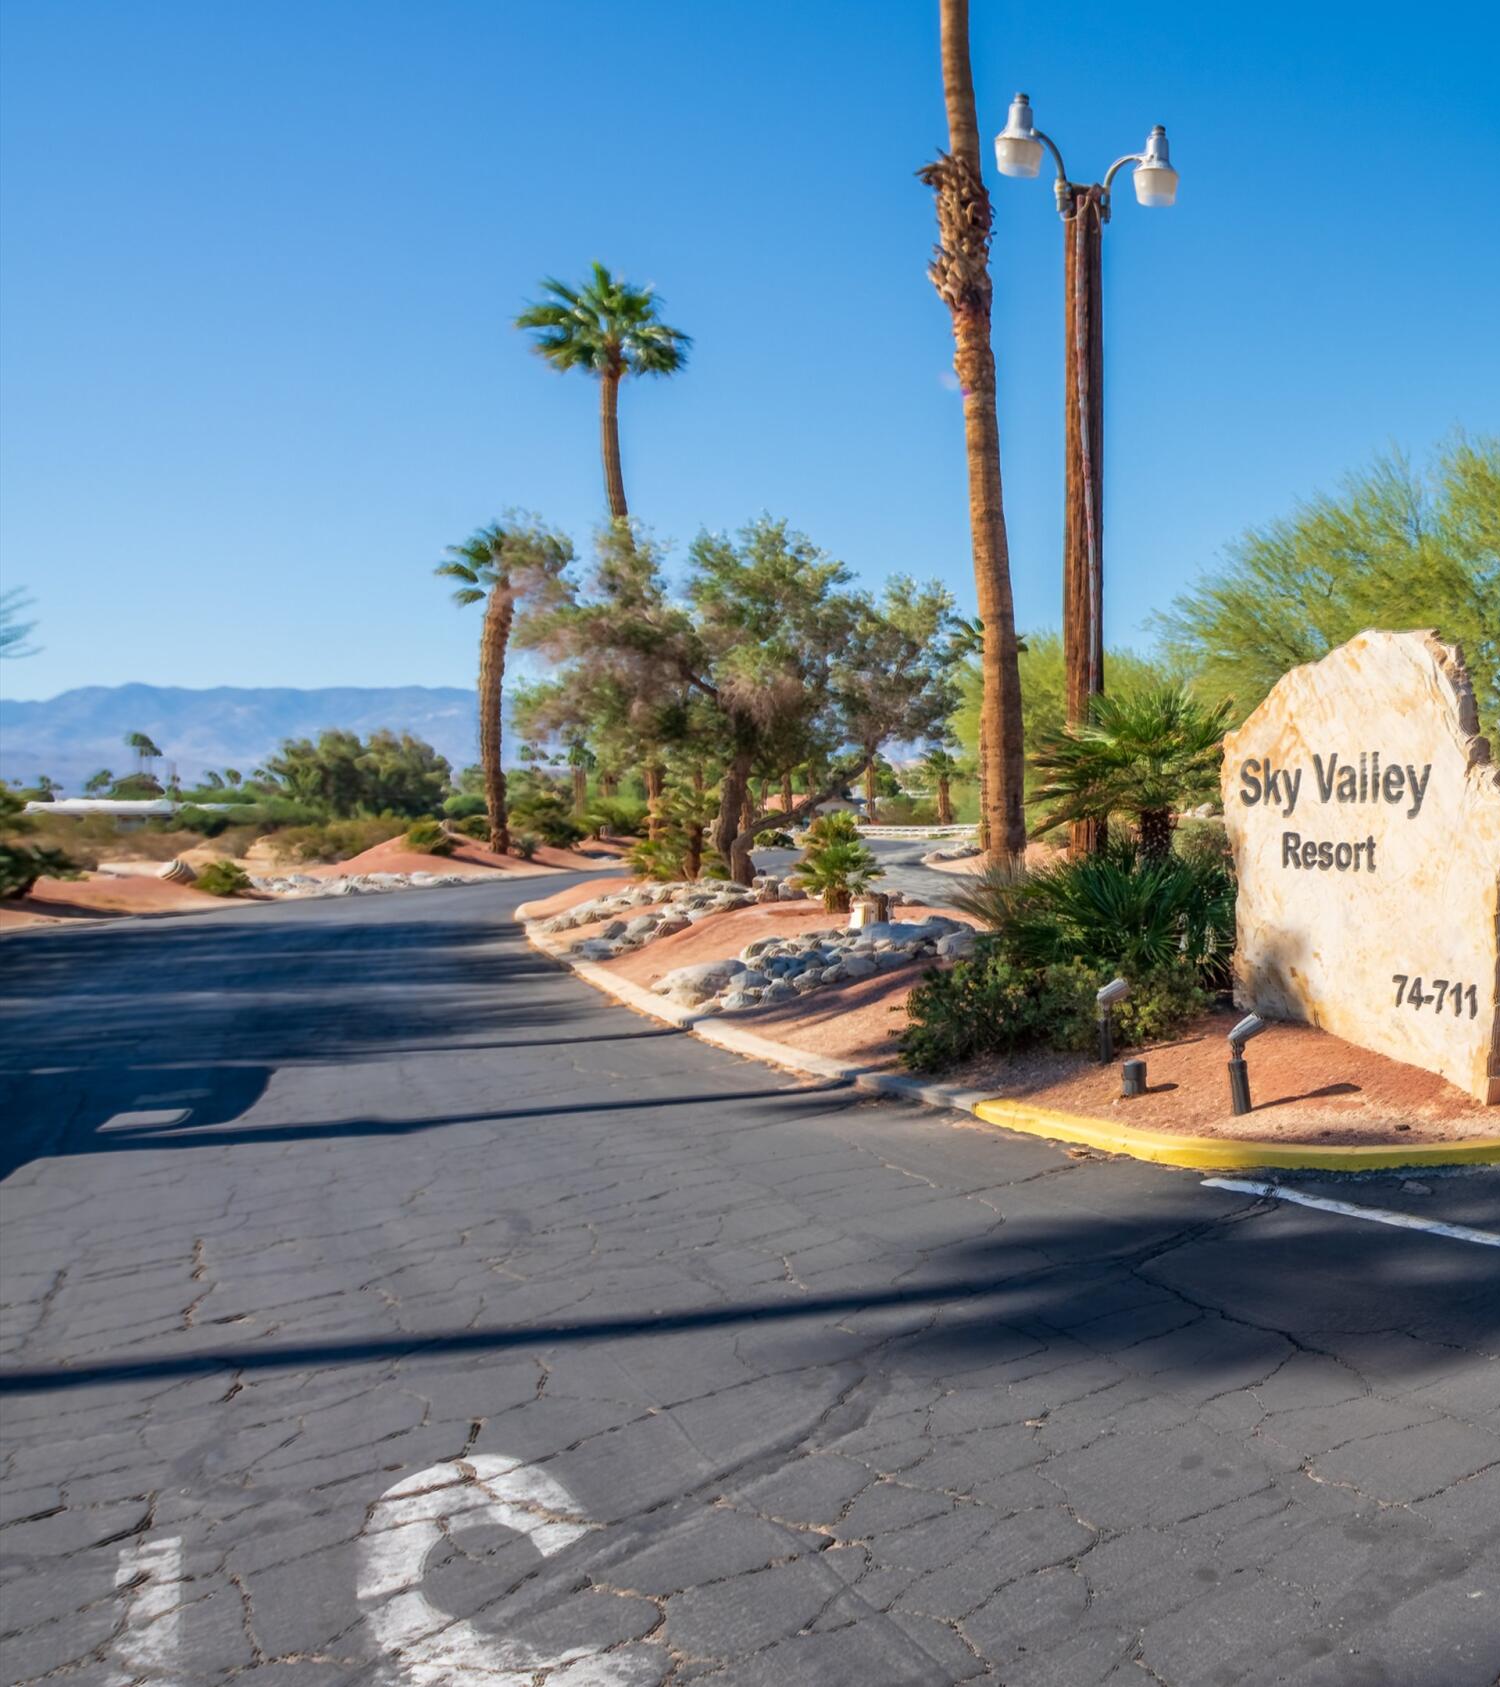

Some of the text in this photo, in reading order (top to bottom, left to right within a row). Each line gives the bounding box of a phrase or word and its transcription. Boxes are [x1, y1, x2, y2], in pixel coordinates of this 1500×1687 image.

[1240, 751, 1432, 820] Sky Valley
[1282, 831, 1377, 874] Resort
[1391, 974, 1478, 1020] 74-711
